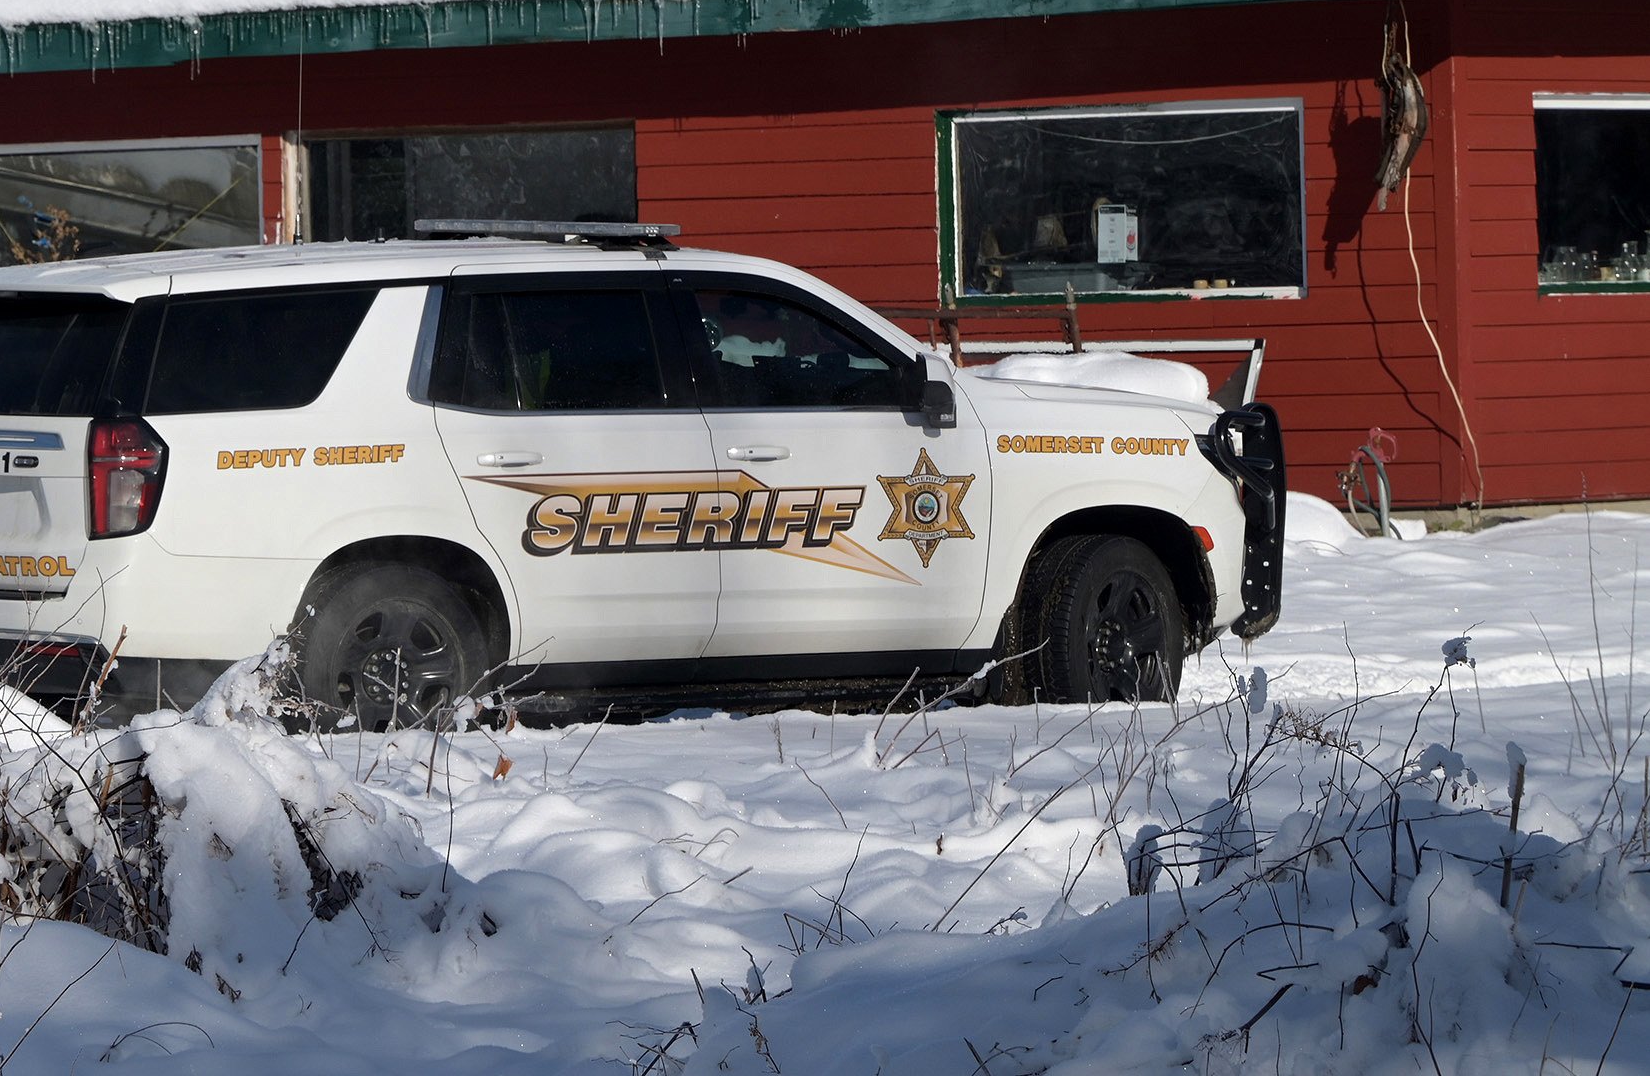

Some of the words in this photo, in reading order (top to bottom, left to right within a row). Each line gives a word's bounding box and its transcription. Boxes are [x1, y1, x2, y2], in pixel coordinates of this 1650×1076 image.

[997, 435, 1104, 453] SOMERSET
[1111, 437, 1189, 456] COUNTY
[217, 448, 306, 469] DEPUTY
[313, 444, 405, 466] SHERIFF
[909, 485, 944, 500] SOMERSET
[521, 485, 866, 557] SHERIFF
[911, 519, 940, 531] COUNTY
